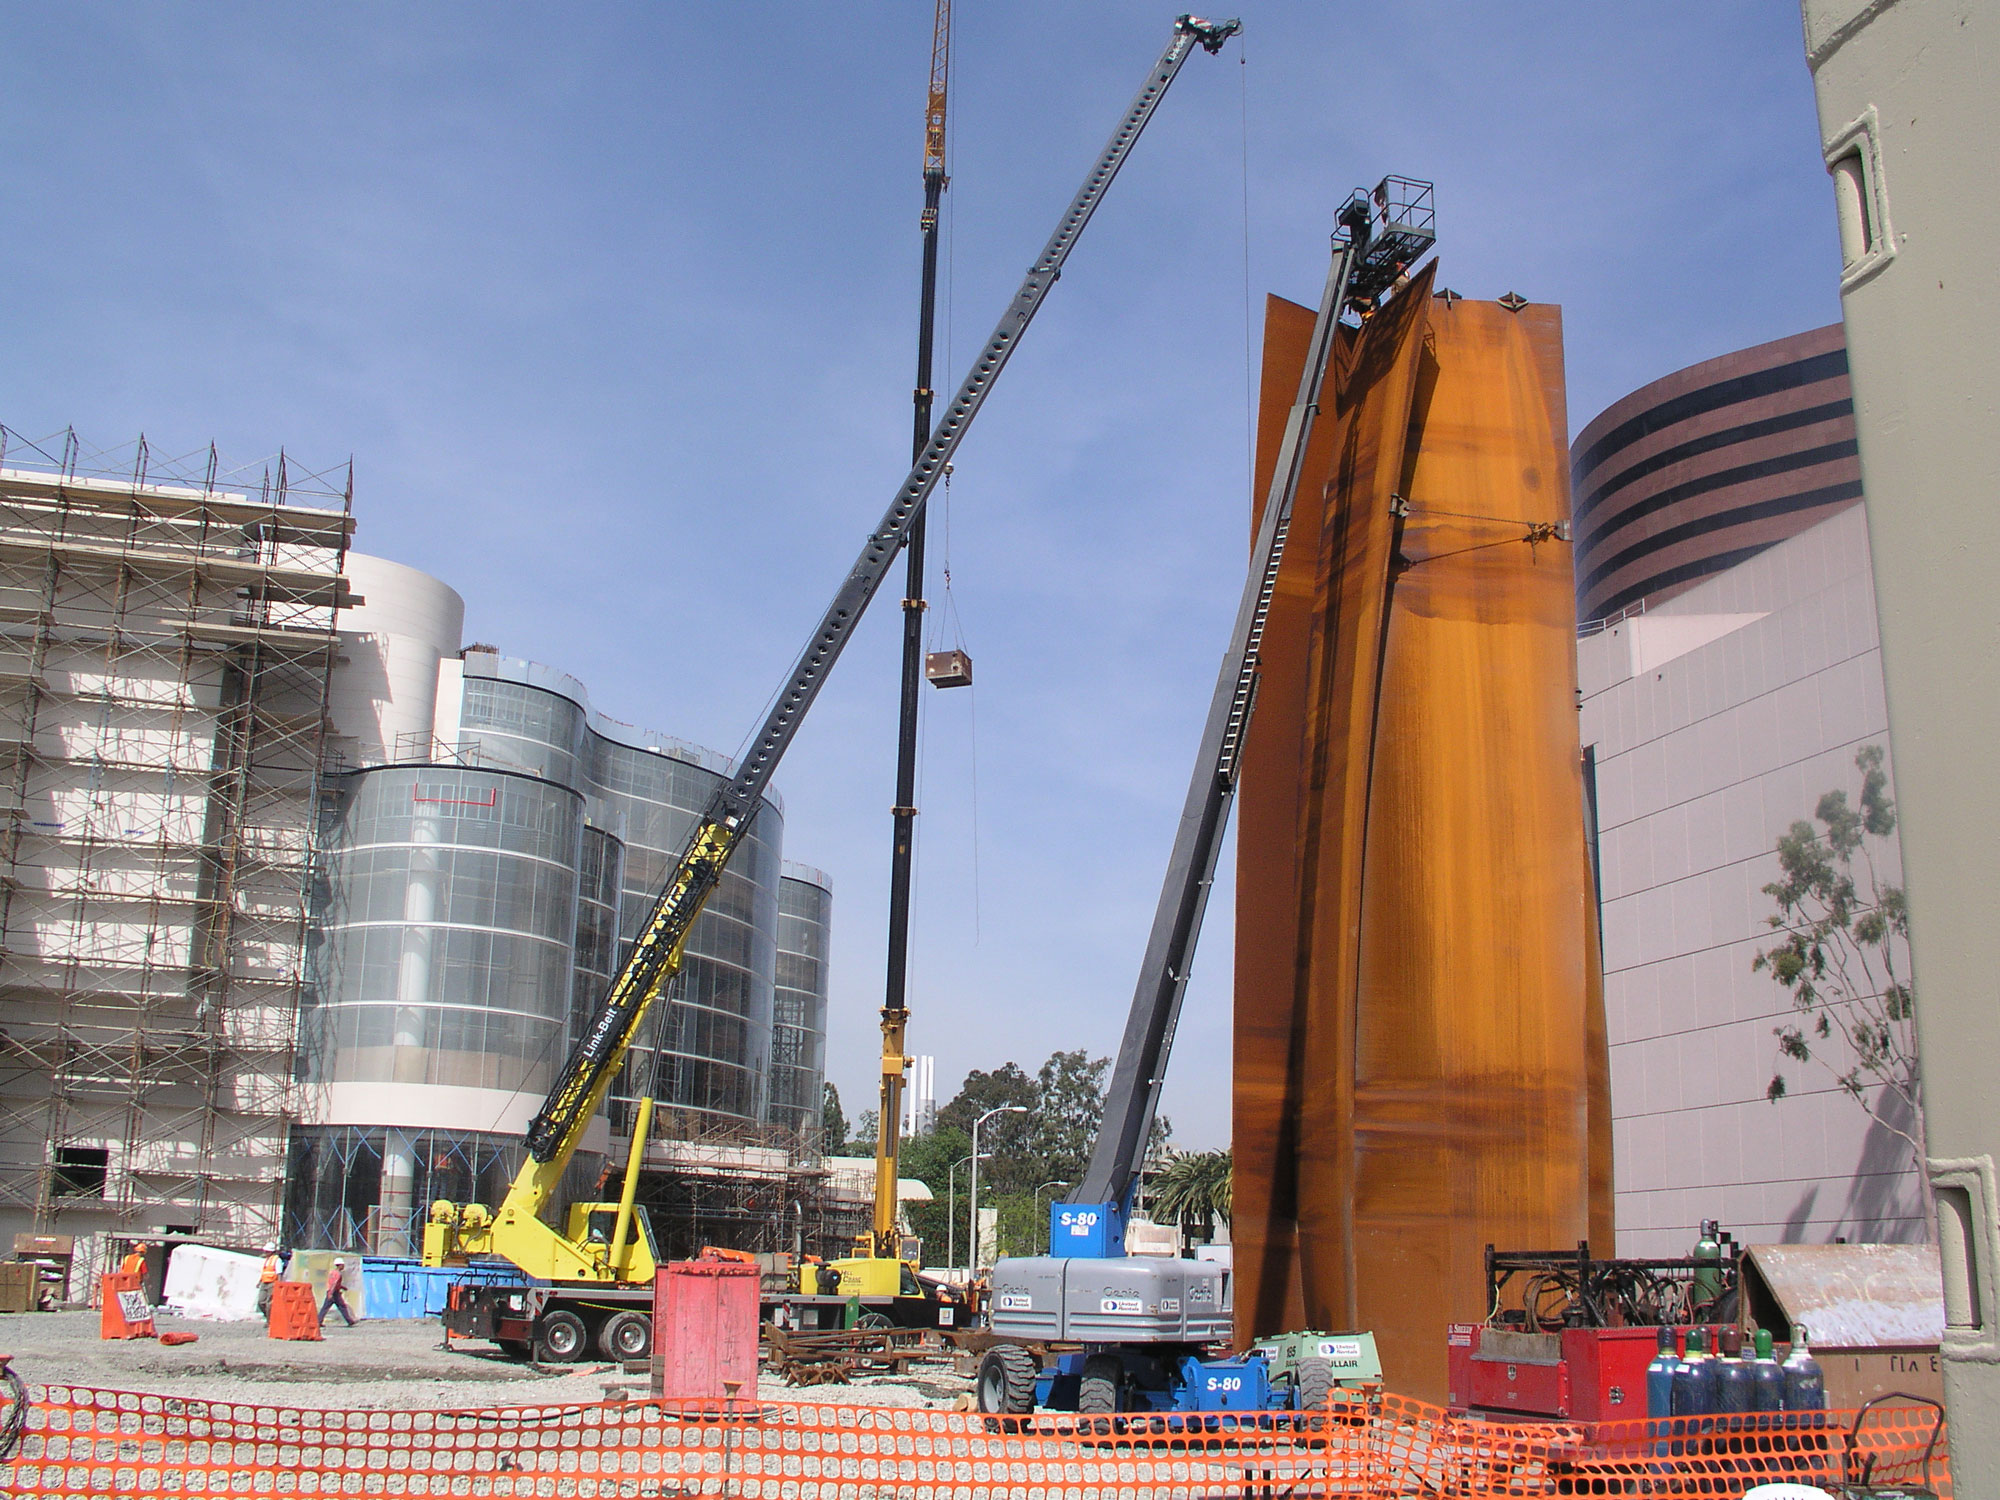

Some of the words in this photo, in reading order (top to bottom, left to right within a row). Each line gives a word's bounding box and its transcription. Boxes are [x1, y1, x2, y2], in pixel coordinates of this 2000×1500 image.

[583, 1008, 618, 1058] Link-Belt
[1060, 1211, 1097, 1226] S-80
[1207, 1377, 1241, 1391] S-80
